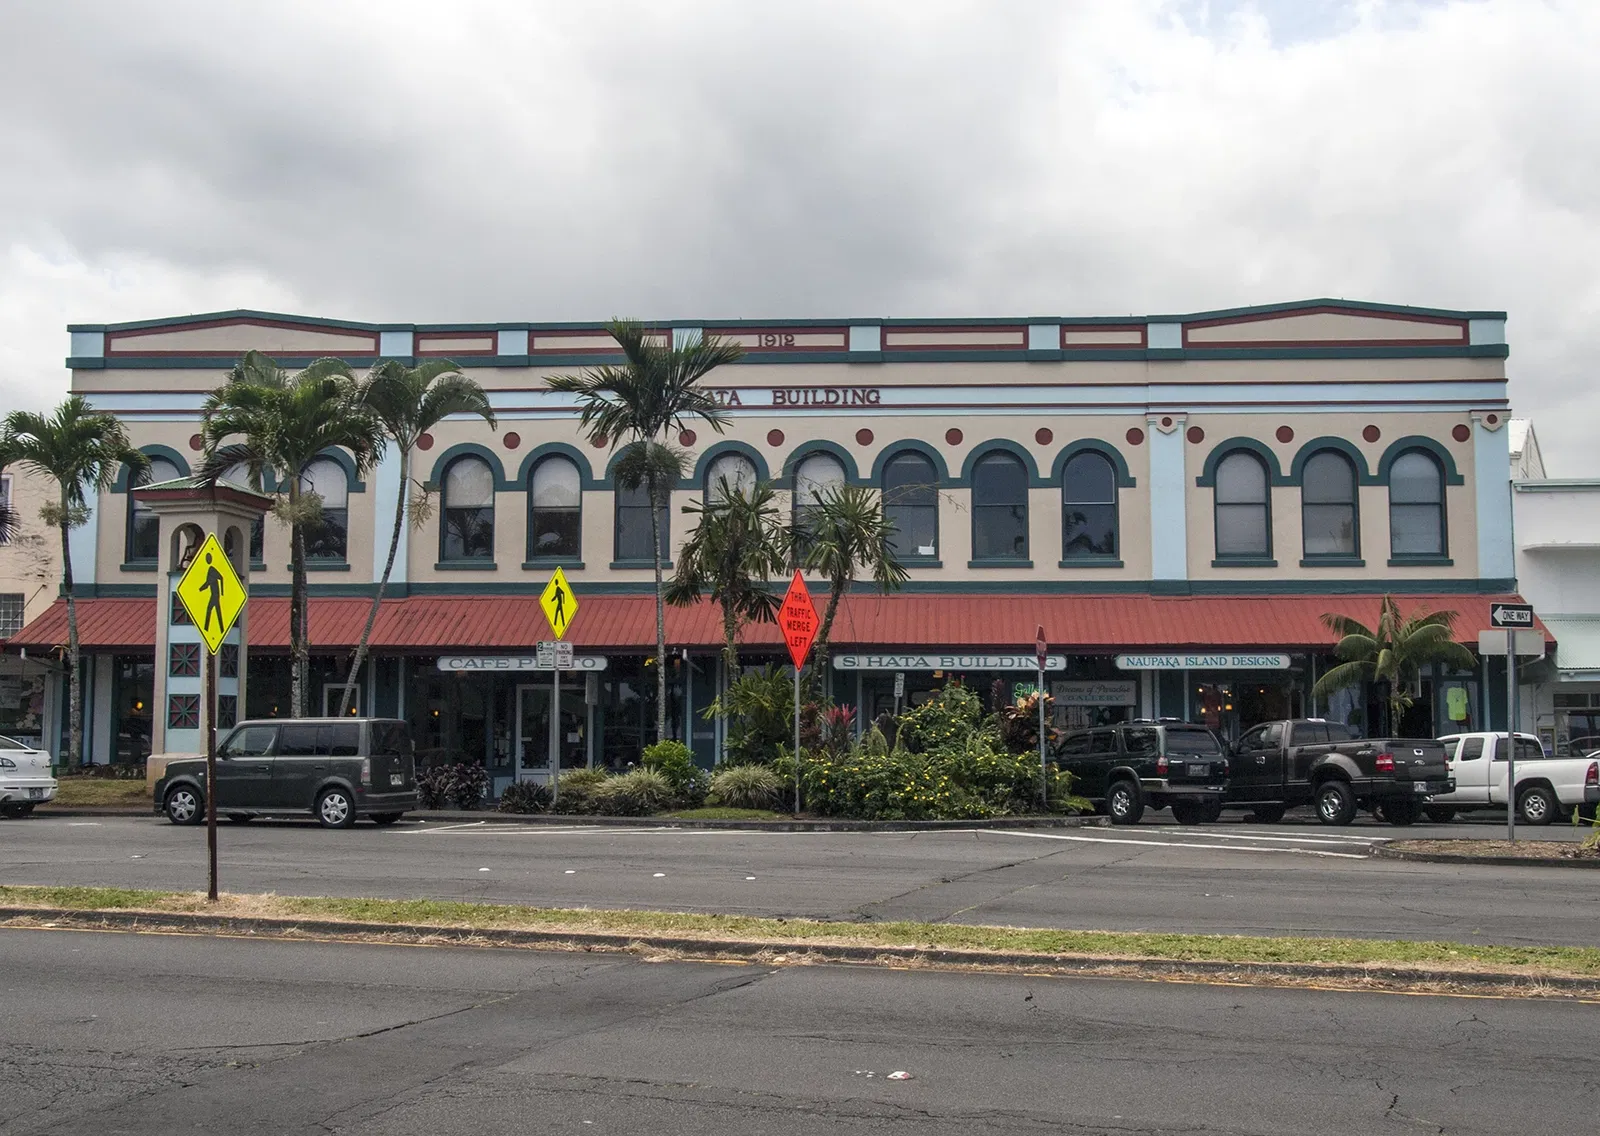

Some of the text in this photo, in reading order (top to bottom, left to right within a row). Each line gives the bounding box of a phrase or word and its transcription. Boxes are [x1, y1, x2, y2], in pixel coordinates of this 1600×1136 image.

[758, 334, 795, 347] 1912
[772, 389, 881, 405] BUILDING
[791, 591, 807, 604] THRU
[786, 606, 811, 620] TRAFFIC
[1502, 610, 1529, 621] ONE WAY
[786, 620, 811, 633] MERGE
[790, 636, 808, 649] LEFT
[449, 658, 510, 669] CAFE
[516, 658, 597, 669] PTO
[866, 656, 931, 668] HATA
[939, 656, 1058, 668] BUILDING
[1126, 656, 1281, 668] NAUPAKA ISLAND DESIGNS
